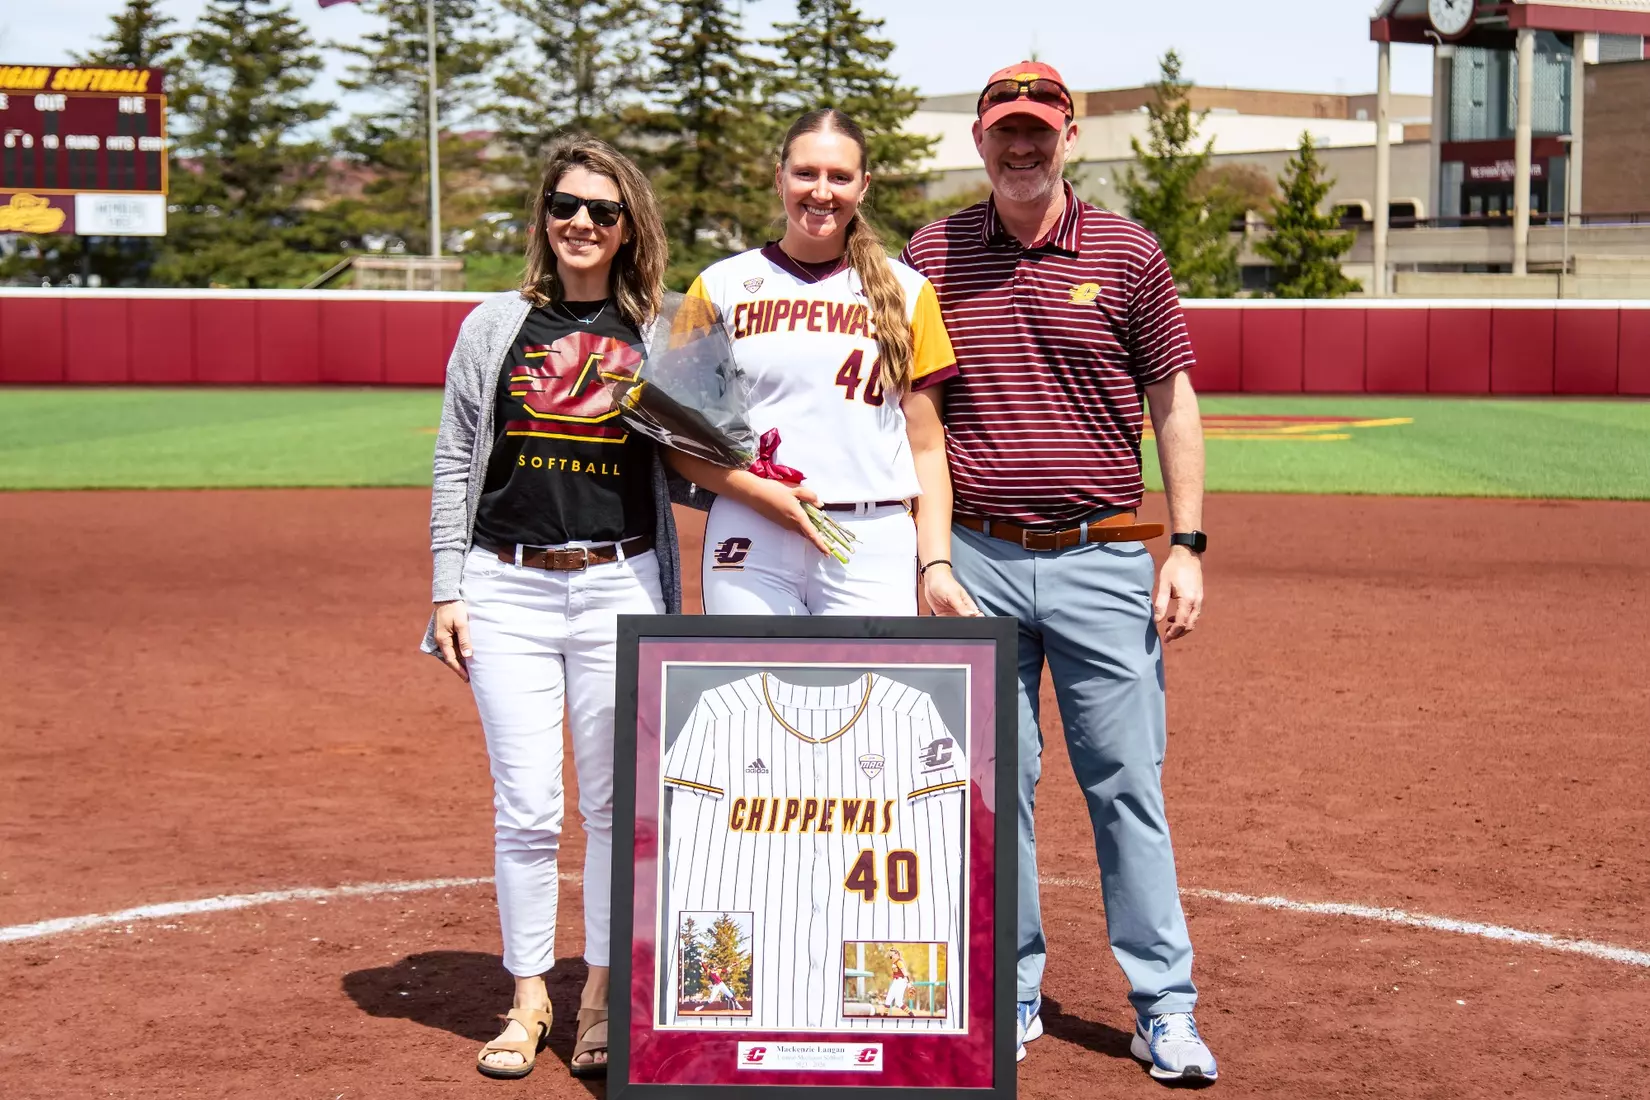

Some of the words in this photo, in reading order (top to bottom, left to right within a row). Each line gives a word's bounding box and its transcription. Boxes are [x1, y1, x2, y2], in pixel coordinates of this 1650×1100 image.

[51, 67, 150, 92] SOFTBALL
[734, 298, 880, 340] CHIPPEWA
[518, 454, 621, 476] SOFTBALL
[729, 796, 896, 835] CHIPPEWAS
[843, 847, 920, 905] 40
